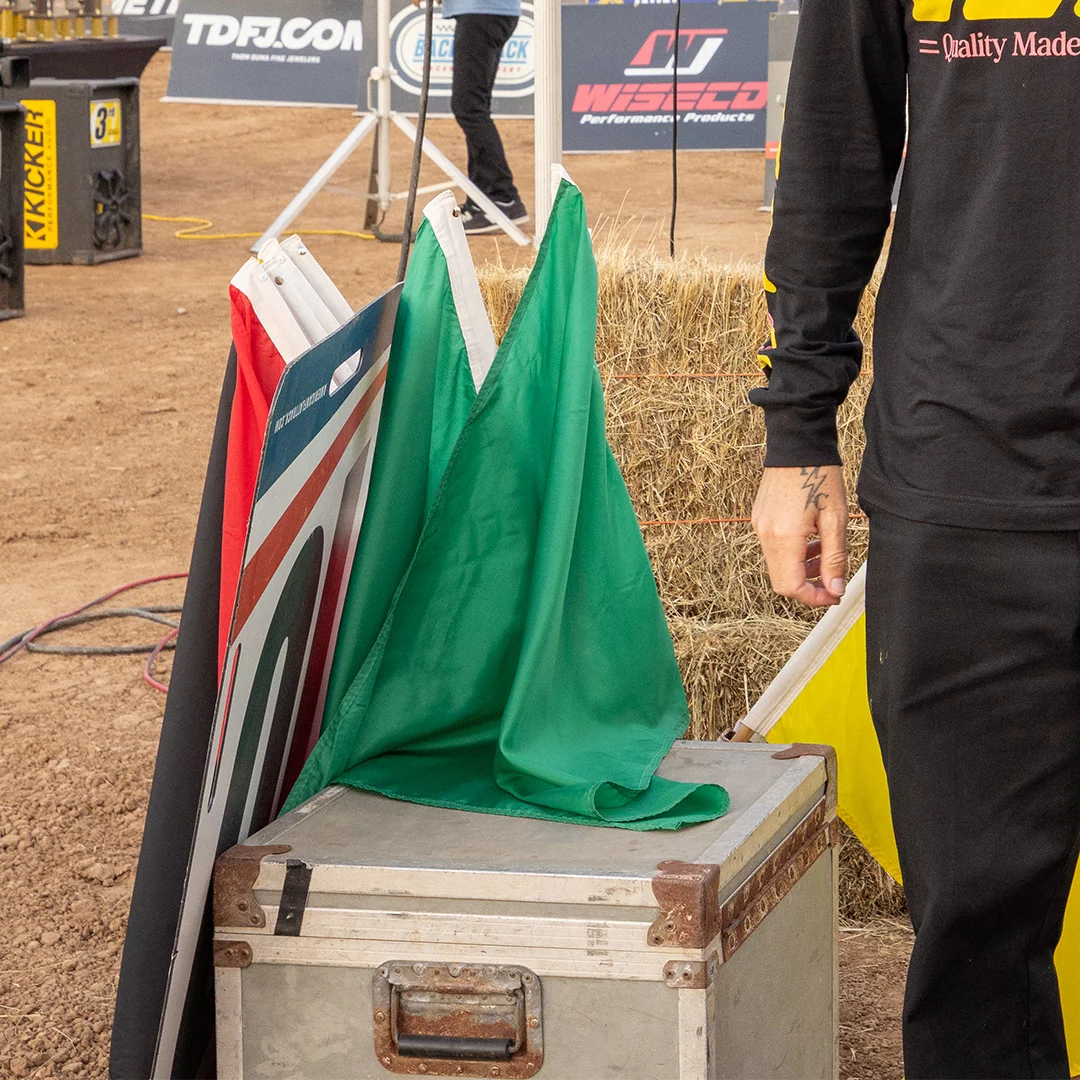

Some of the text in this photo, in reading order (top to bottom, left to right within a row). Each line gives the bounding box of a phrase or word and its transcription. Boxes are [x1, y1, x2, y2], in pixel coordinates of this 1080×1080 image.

[942, 32, 1006, 63] Quality
[683, 112, 756, 124] Products
[24, 108, 45, 217] KICKER
